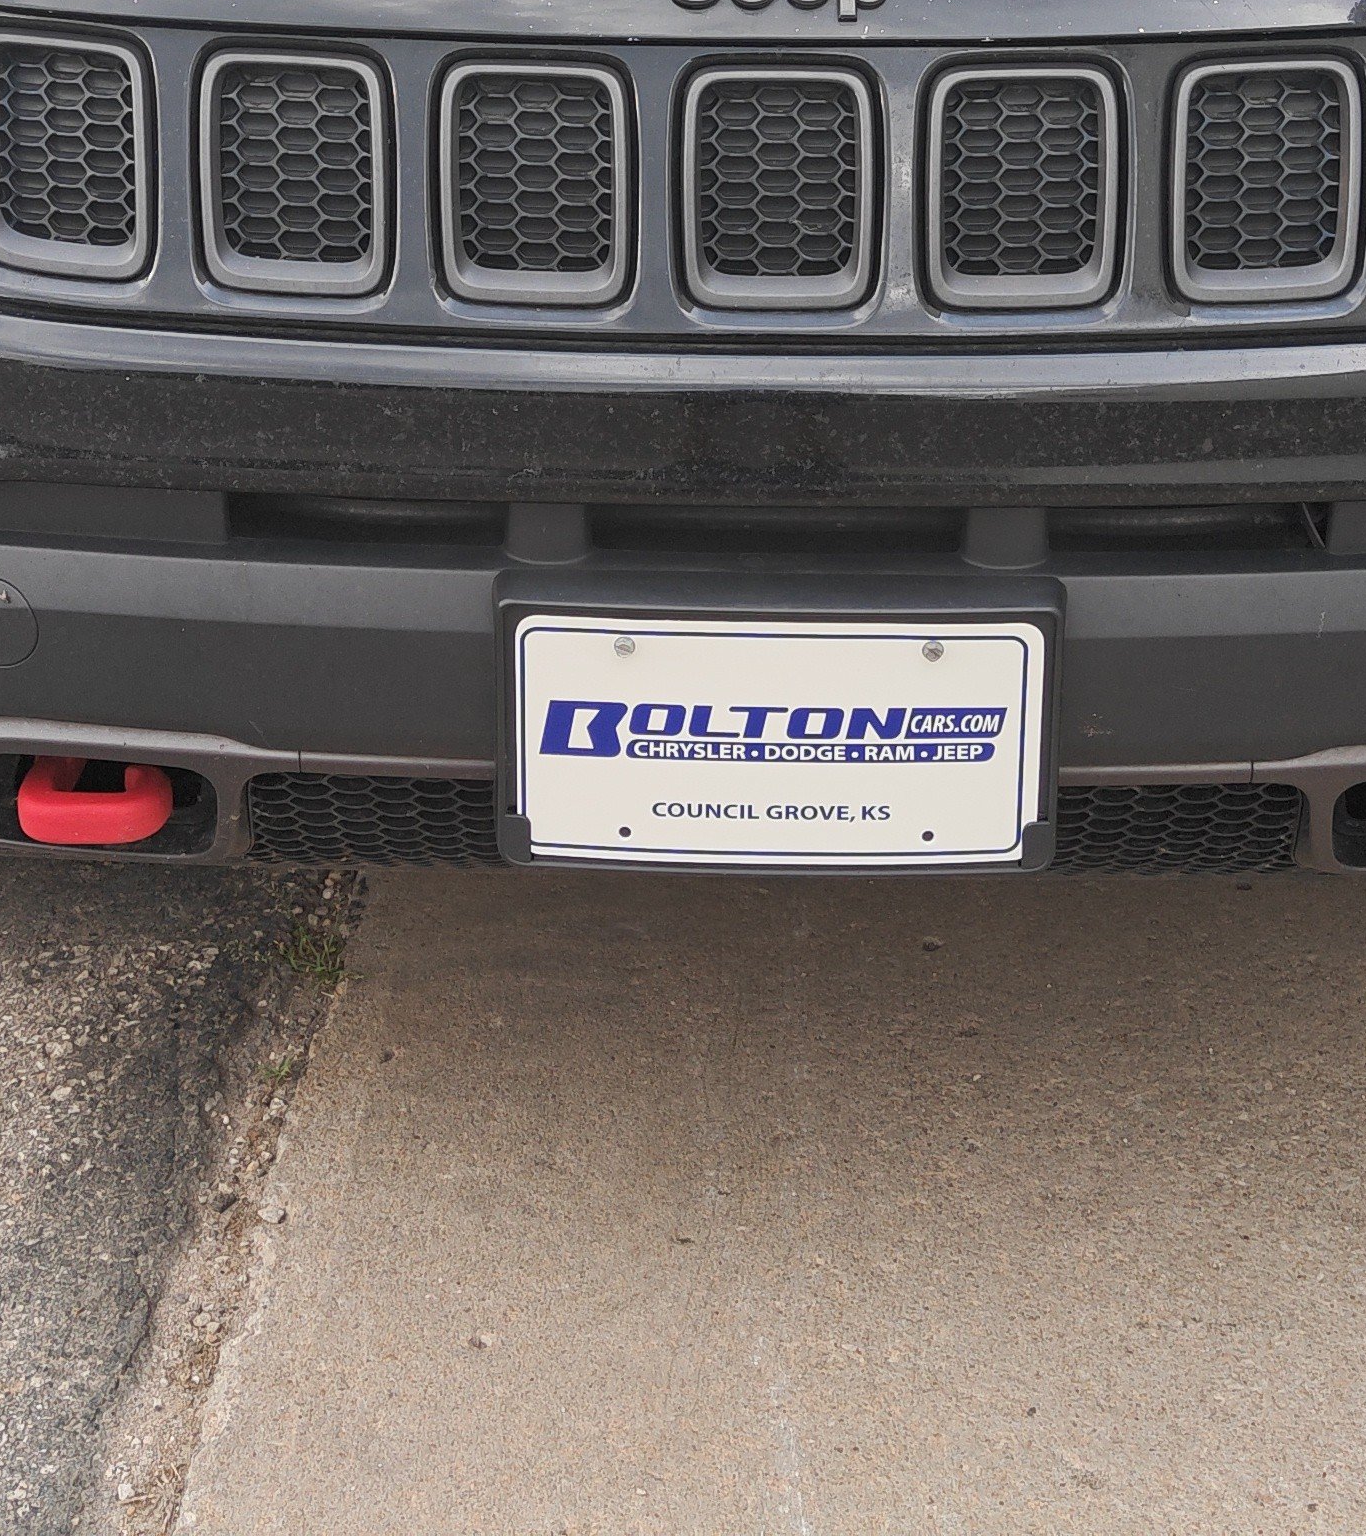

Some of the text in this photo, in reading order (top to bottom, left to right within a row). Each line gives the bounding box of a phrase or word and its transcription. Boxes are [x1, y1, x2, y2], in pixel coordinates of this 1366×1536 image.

[539, 700, 1001, 758] BOLTON CARS.COM
[633, 741, 983, 761] CHRYSLER DODGE RAM JEEP
[651, 801, 891, 823] COUNCIL GROVE, KS
